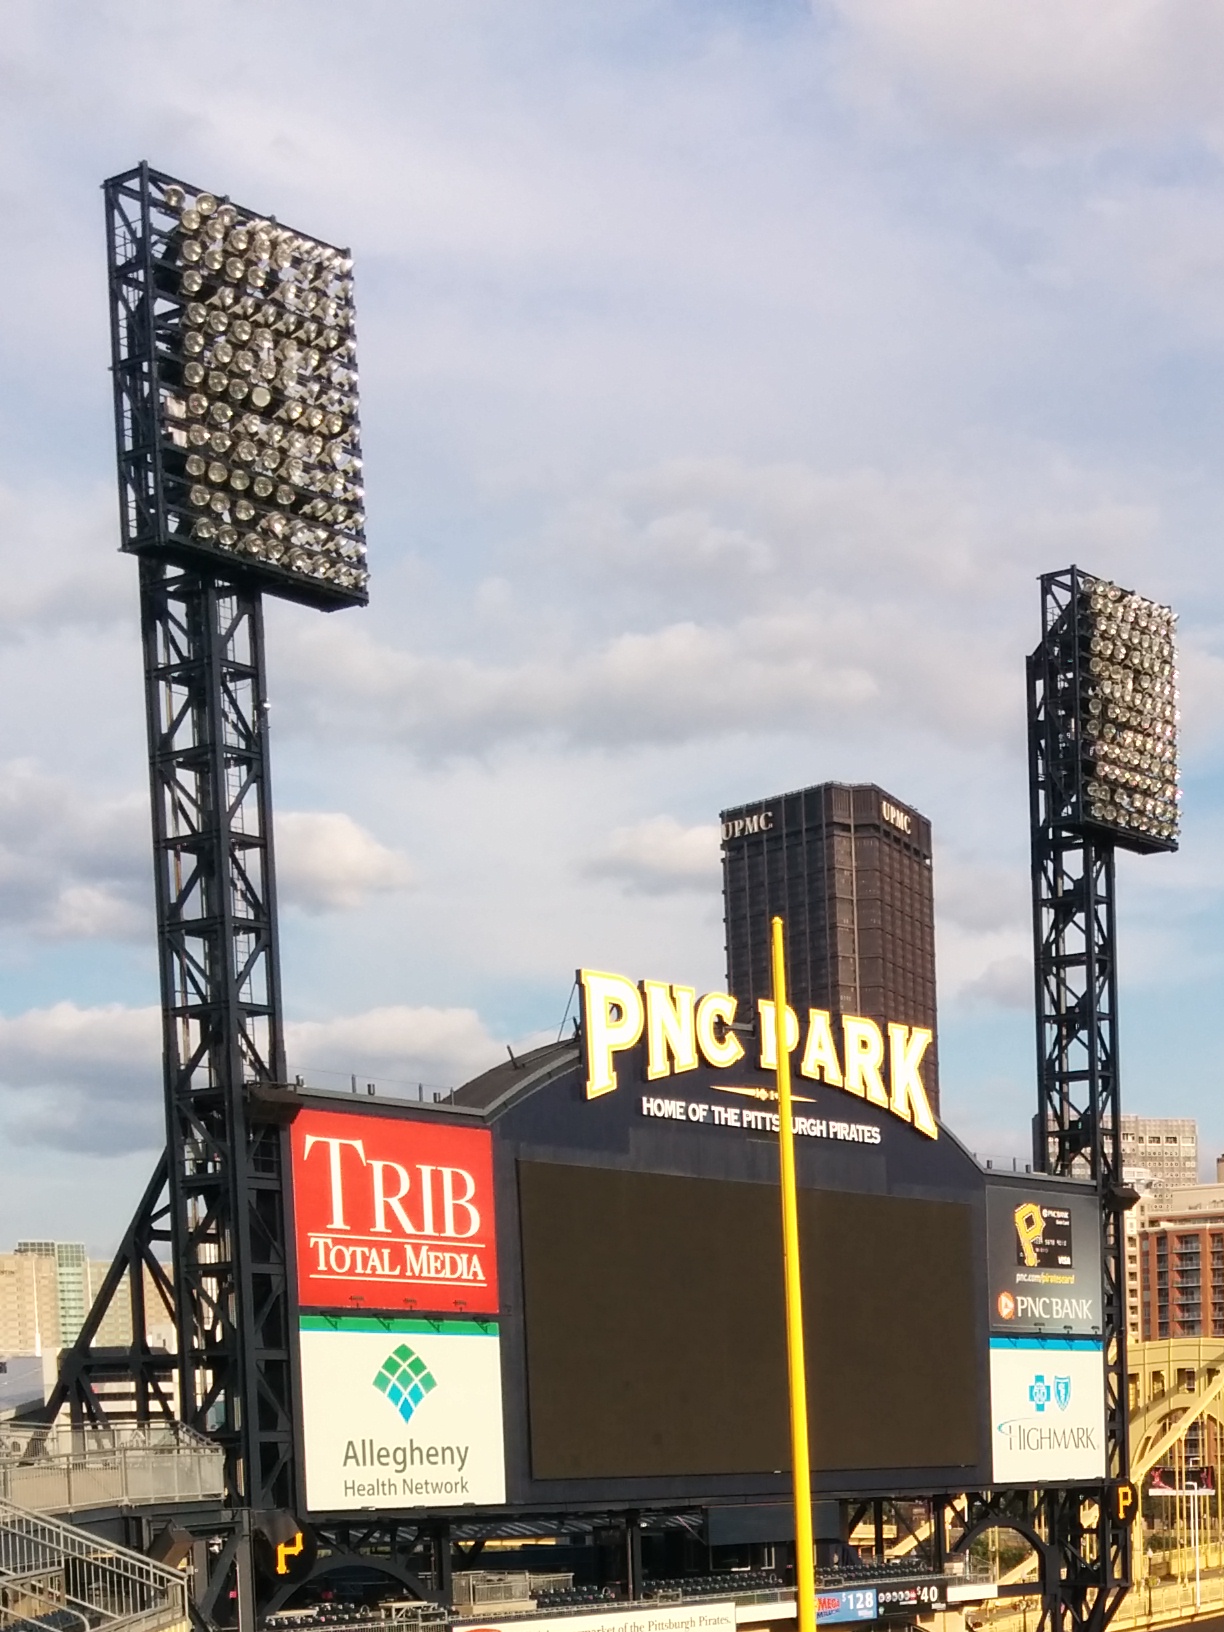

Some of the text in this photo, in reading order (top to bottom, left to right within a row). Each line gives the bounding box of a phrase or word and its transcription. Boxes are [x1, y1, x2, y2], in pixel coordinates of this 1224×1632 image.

[722, 811, 773, 840] UPMC
[882, 800, 911, 835] UPMC
[576, 968, 938, 1139] PNC PARK
[642, 1097, 881, 1144] HOME OF THE PITTSURGH PIRATES
[303, 1134, 481, 1239] TRIB
[309, 1237, 486, 1280] TOTAL MEDIA
[1016, 1296, 1093, 1319] PNC BANK
[1009, 1424, 1096, 1451] HIGHMARK
[343, 1439, 470, 1473] Allegheny
[344, 1476, 469, 1497] Health Network
[1118, 1485, 1132, 1519] P
[917, 1586, 938, 1602] $40
[648, 1616, 696, 1632] Pittsburgh
[698, 1614, 732, 1627] Pirates.
